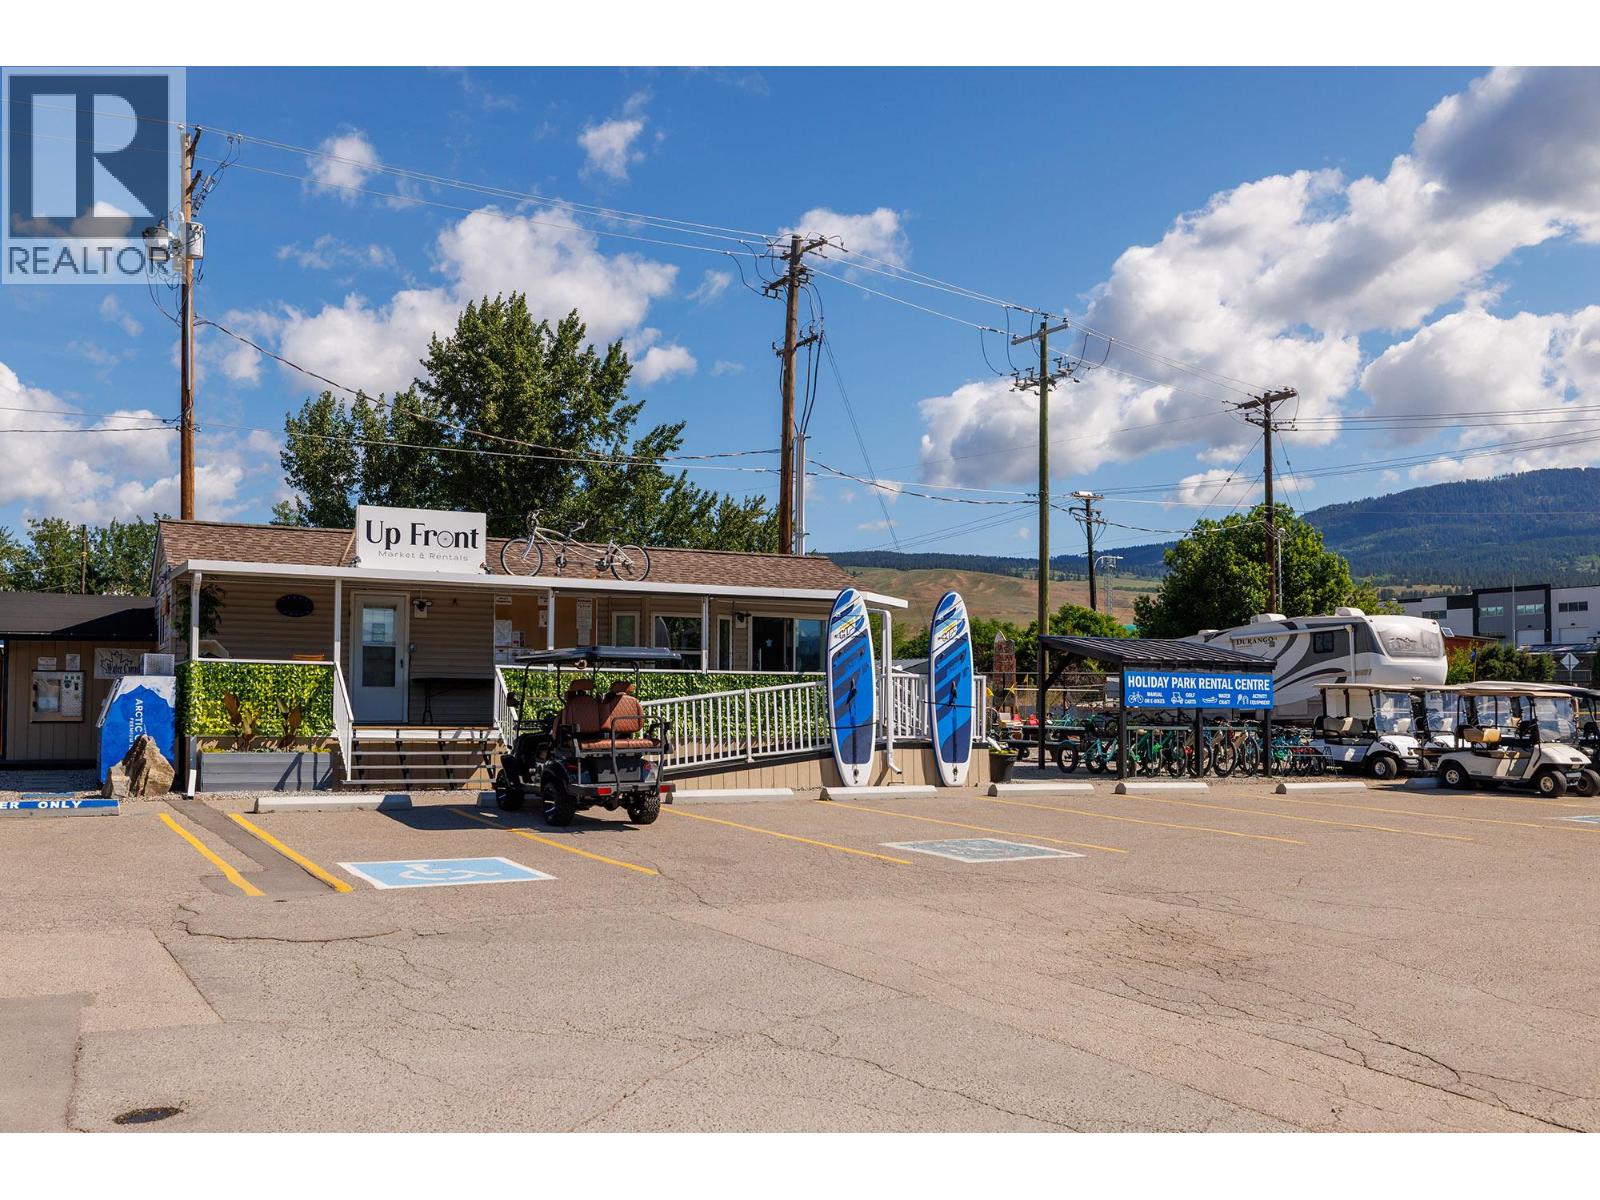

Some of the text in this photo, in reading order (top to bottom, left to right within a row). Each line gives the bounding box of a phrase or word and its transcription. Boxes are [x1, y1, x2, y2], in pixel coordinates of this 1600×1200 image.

[366, 519, 479, 550] Up Front
[378, 550, 416, 558] Market
[429, 553, 469, 561] Rentals
[1236, 636, 1274, 645] DURANGO
[1127, 675, 1270, 691] HOLIDAY PARK RENTAL CENTRE
[134, 698, 144, 733] ARCTIC
[37, 800, 83, 809] ONLY
